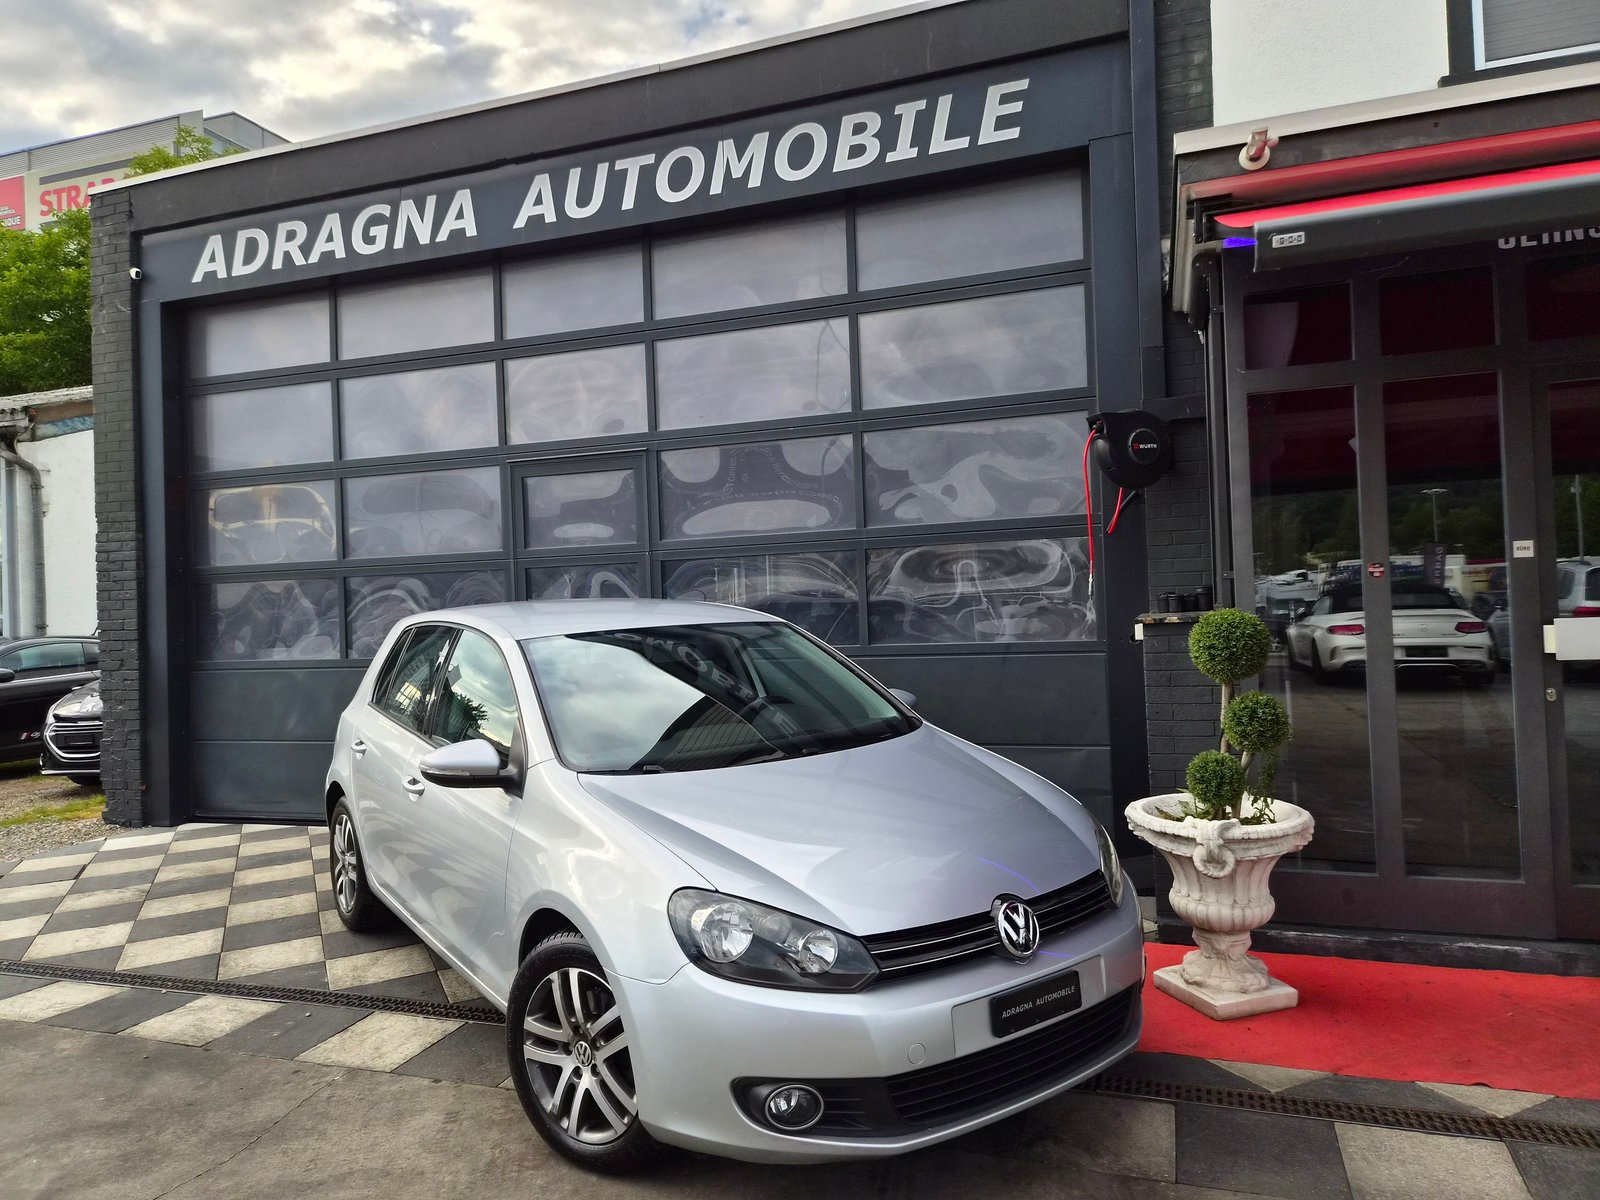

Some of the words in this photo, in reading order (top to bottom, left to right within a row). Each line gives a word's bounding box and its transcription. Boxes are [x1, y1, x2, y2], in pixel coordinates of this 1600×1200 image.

[192, 188, 478, 283] ADRAGNA
[513, 78, 1030, 230] AUTOMOBILE
[1002, 1001, 1033, 1019] ADRAGNA
[1035, 985, 1075, 1007] AUTOMOBILE
